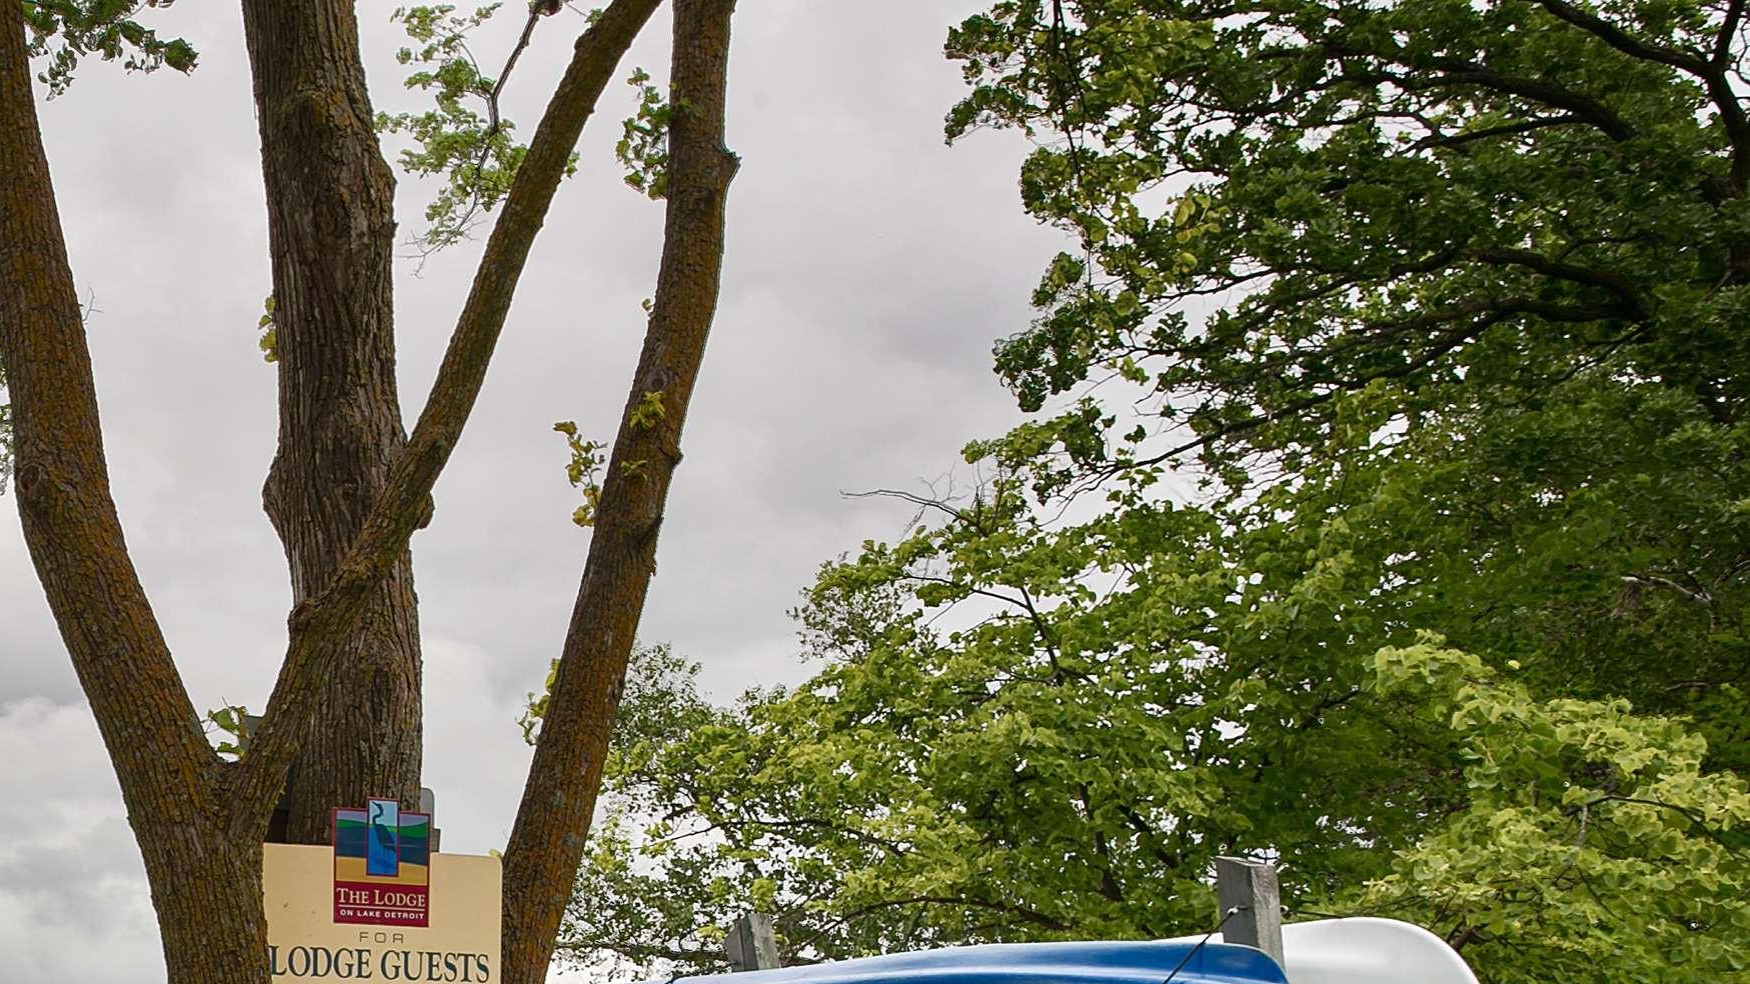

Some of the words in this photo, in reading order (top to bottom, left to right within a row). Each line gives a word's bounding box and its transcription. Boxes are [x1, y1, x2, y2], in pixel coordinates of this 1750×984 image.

[336, 887, 369, 904] THE
[374, 889, 426, 907] LODGE
[340, 909, 354, 917] ON
[357, 910, 381, 918] LAKE
[384, 911, 425, 920] DETROIT
[358, 931, 405, 944] FOR
[268, 945, 372, 979] LODGE
[380, 949, 490, 984] GUESTS
